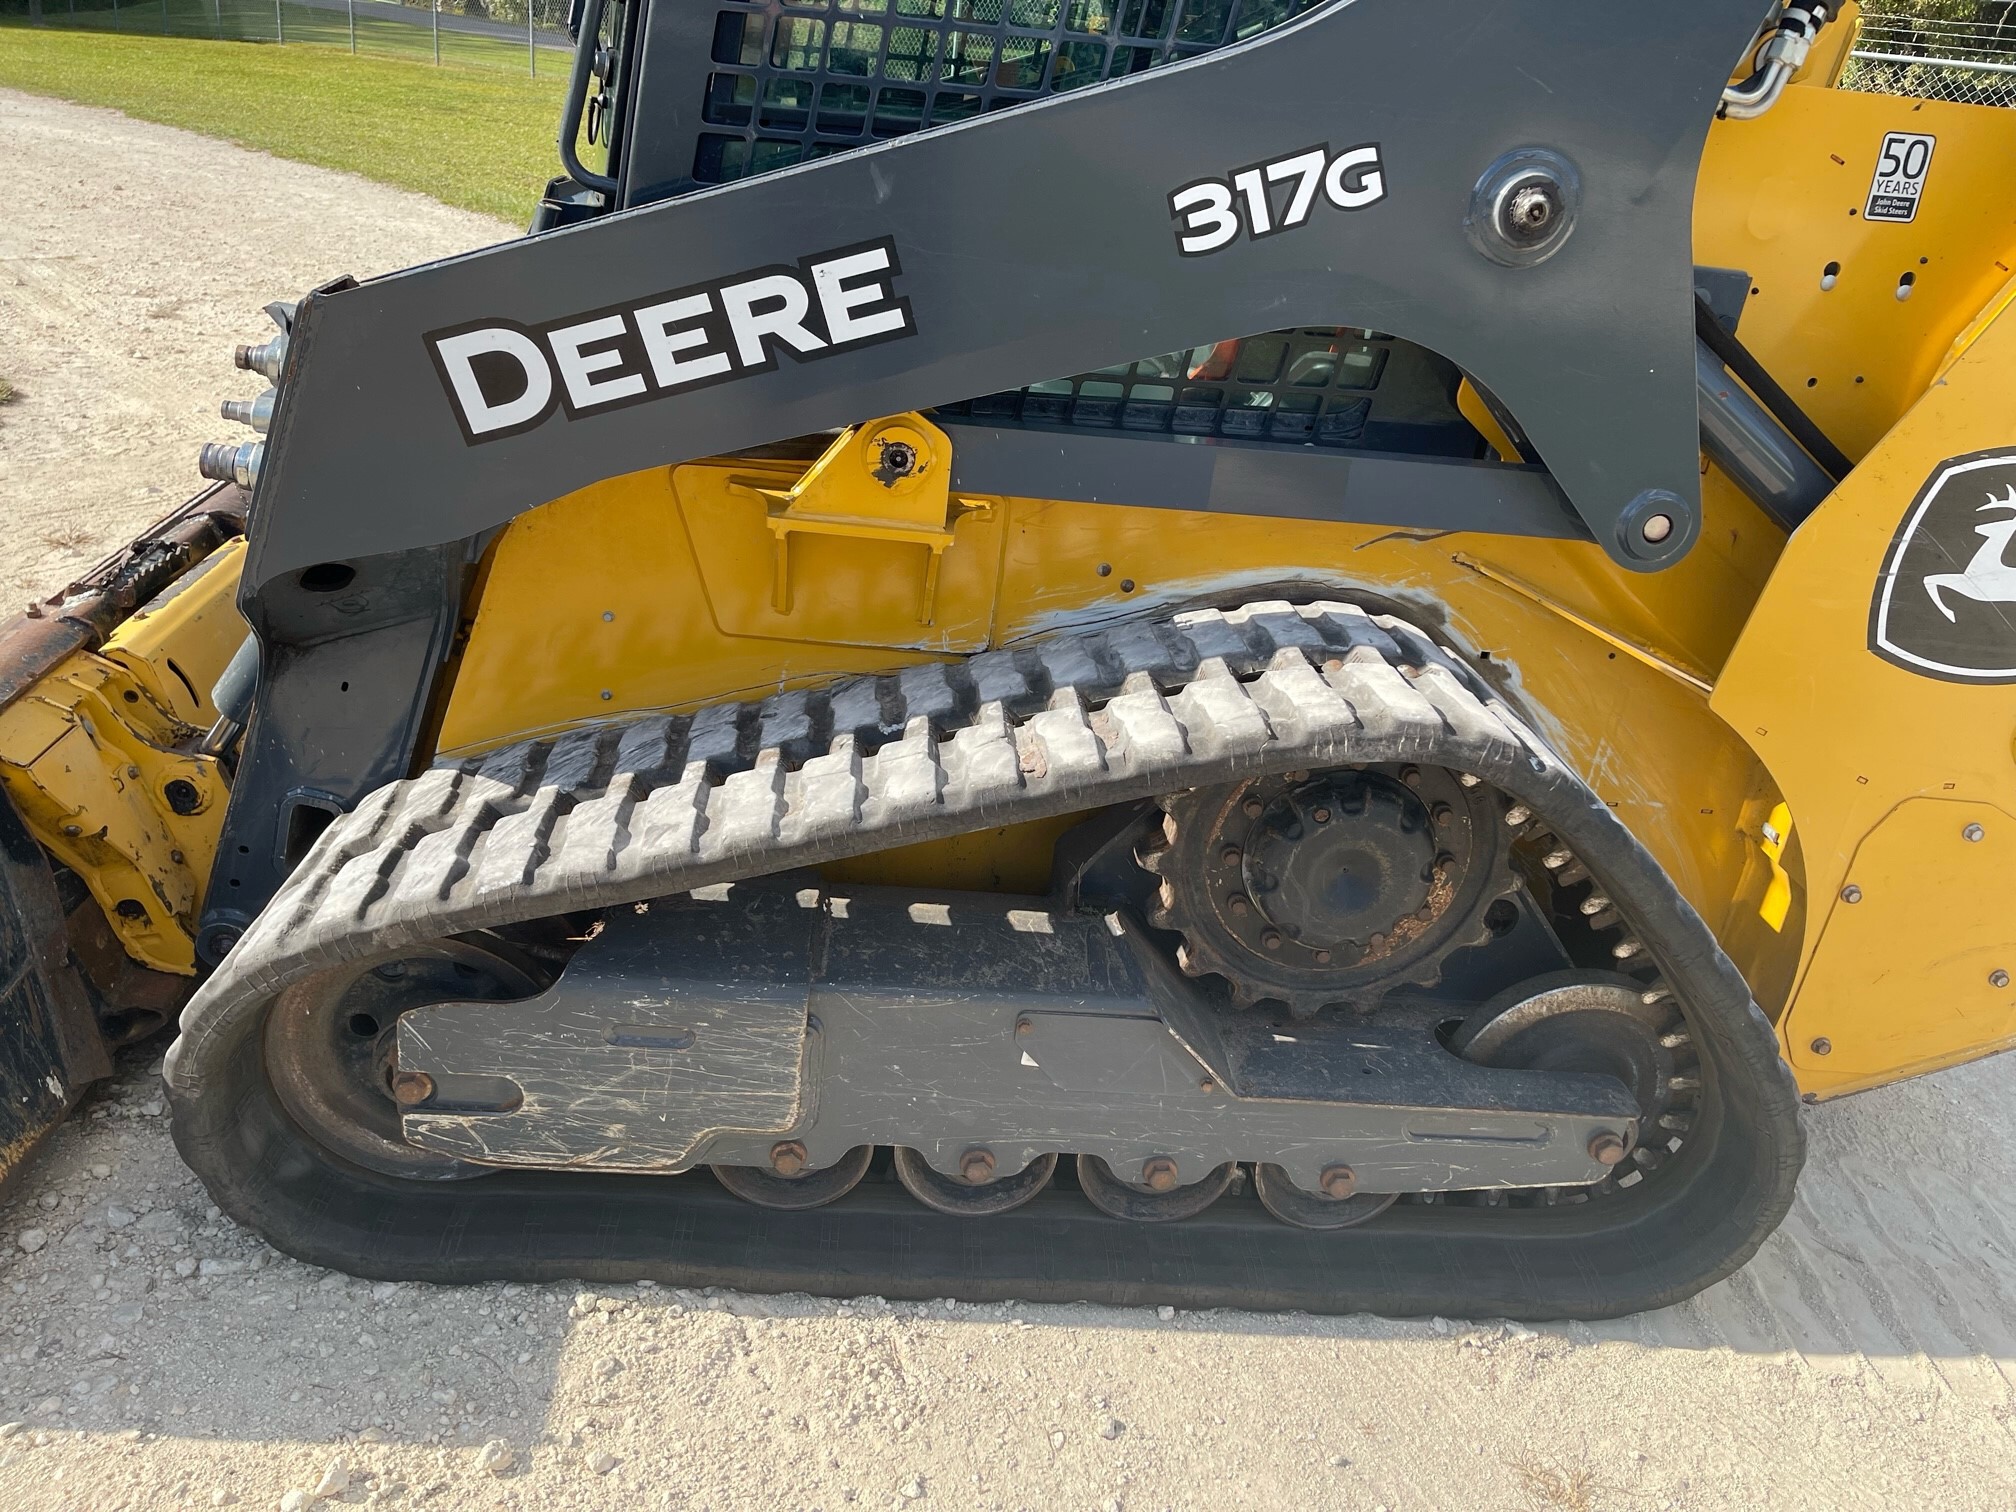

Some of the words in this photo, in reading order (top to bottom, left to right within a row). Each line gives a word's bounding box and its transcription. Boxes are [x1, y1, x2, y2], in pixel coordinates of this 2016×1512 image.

[1879, 138, 1929, 180] 50
[1172, 146, 1385, 254] 317G
[1876, 179, 1919, 195] YEARS
[1874, 206, 1888, 214] Skid
[1888, 207, 1908, 215] Steers
[1876, 198, 1892, 206] John
[1892, 199, 1910, 207] Deere
[435, 247, 906, 435] DEERE
